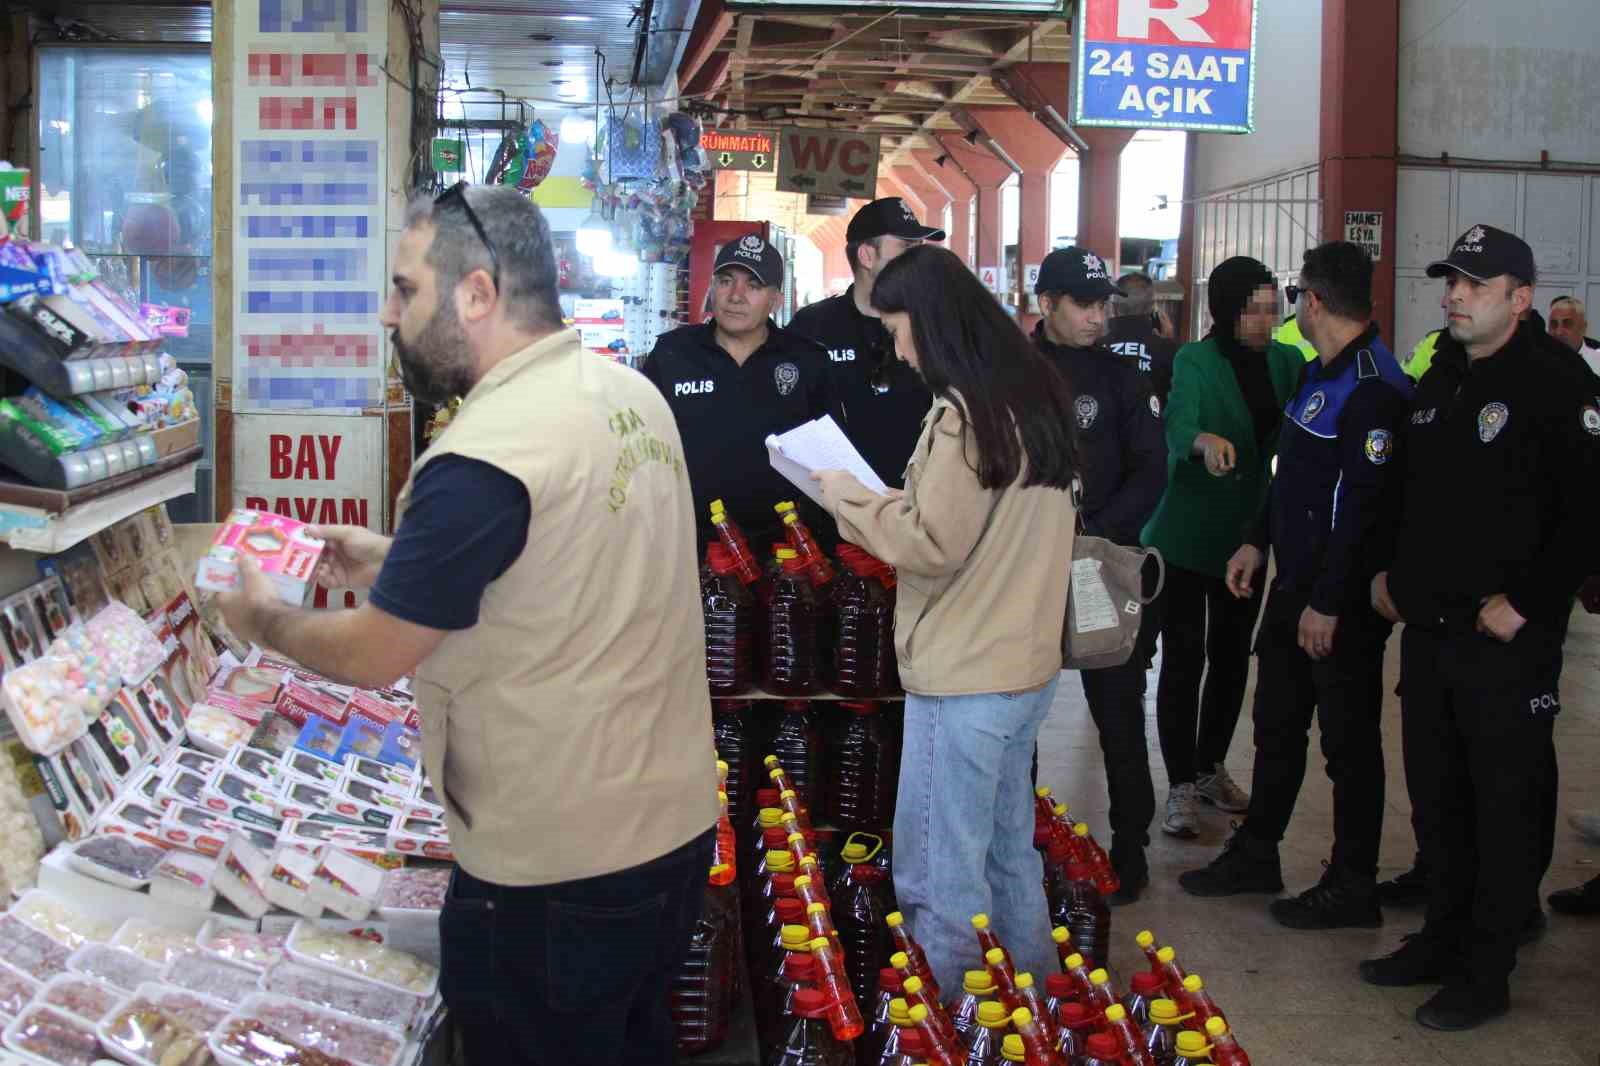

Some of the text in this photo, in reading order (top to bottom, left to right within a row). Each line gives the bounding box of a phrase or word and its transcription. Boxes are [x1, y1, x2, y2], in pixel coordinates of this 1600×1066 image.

[1088, 49, 1245, 82] 24 SAAT
[1117, 84, 1213, 118] AÇIK
[788, 134, 871, 176] WC
[1345, 212, 1381, 226] EMANET
[1109, 342, 1152, 360] ZEL
[269, 434, 342, 480] BAY
[245, 497, 369, 529] YAN
[1529, 693, 1558, 714] POL
